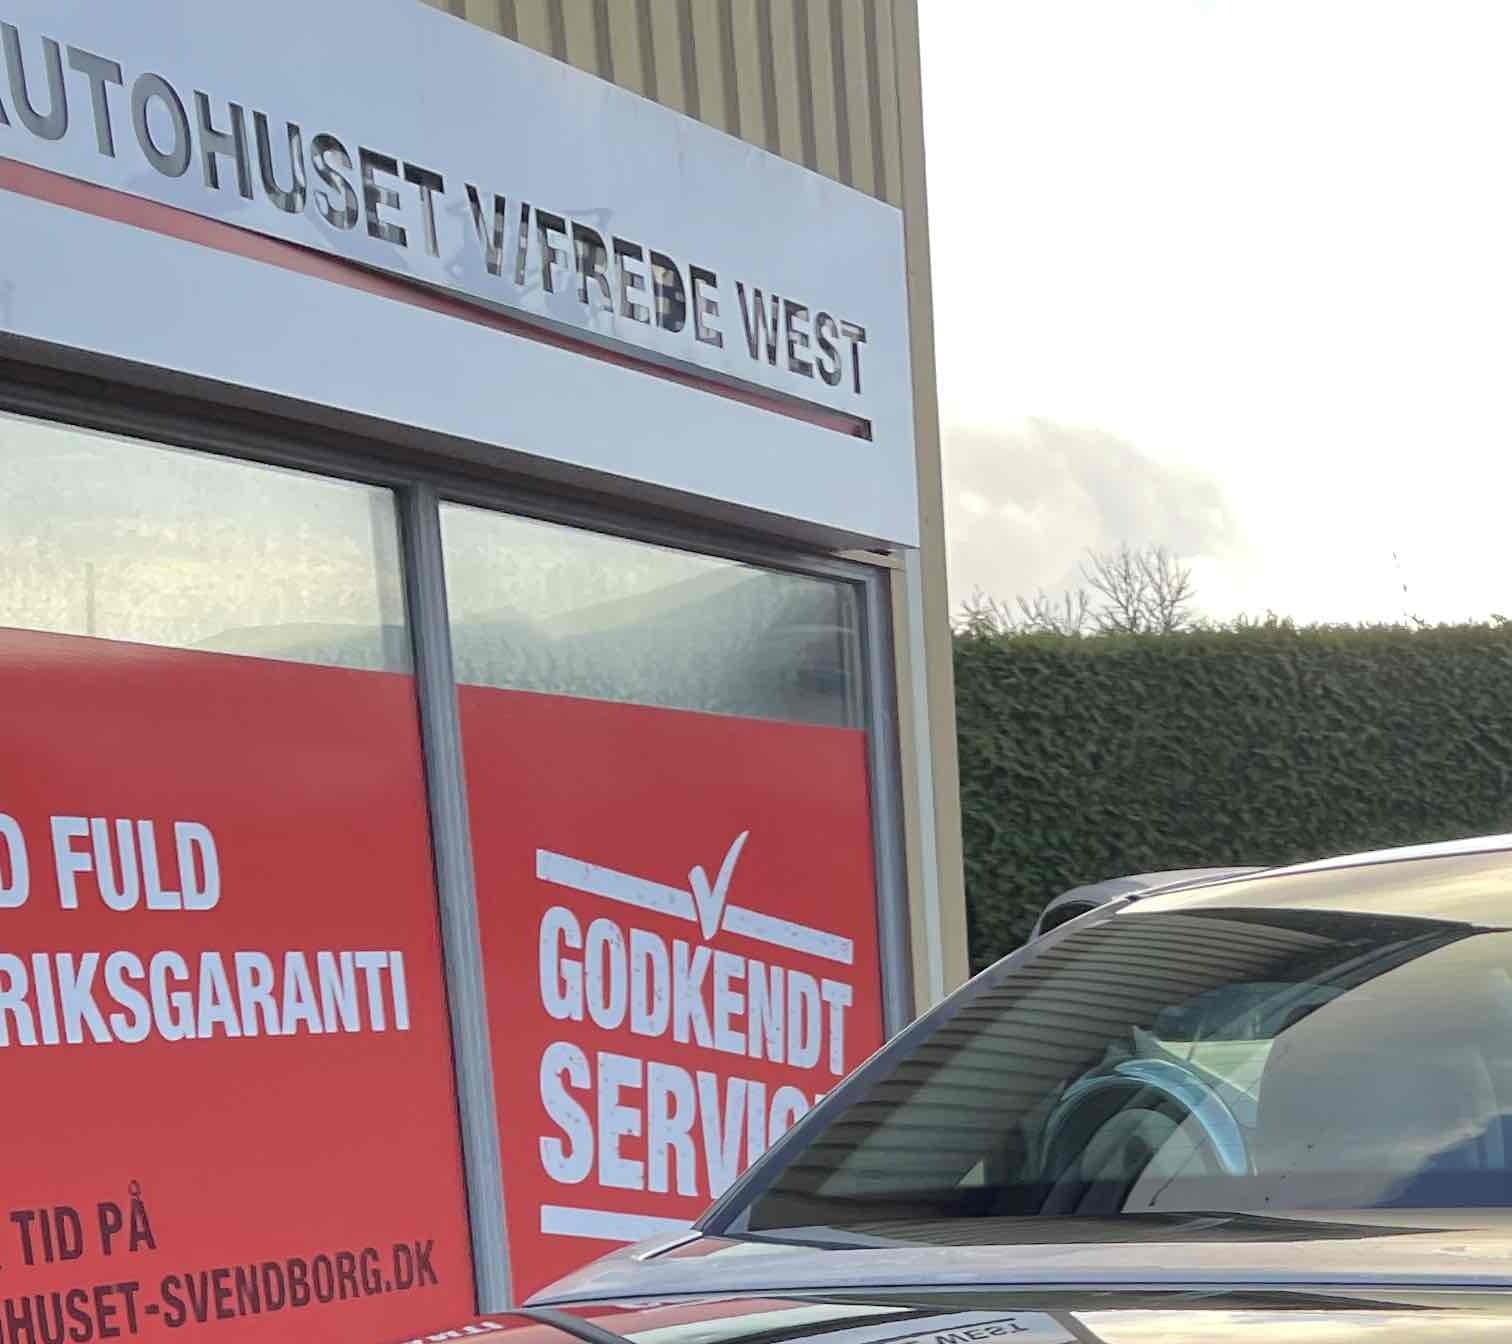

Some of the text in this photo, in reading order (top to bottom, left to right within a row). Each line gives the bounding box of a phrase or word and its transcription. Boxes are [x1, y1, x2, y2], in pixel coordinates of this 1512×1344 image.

[0, 20, 868, 395] UTOHUSET V/FREDE WEST
[50, 815, 221, 912] FULD
[0, 949, 411, 1048] RIKSGARANTI
[538, 905, 854, 1076] GODKENDT
[538, 1040, 832, 1202] SERVI
[10, 1178, 157, 1266] TID PÅ
